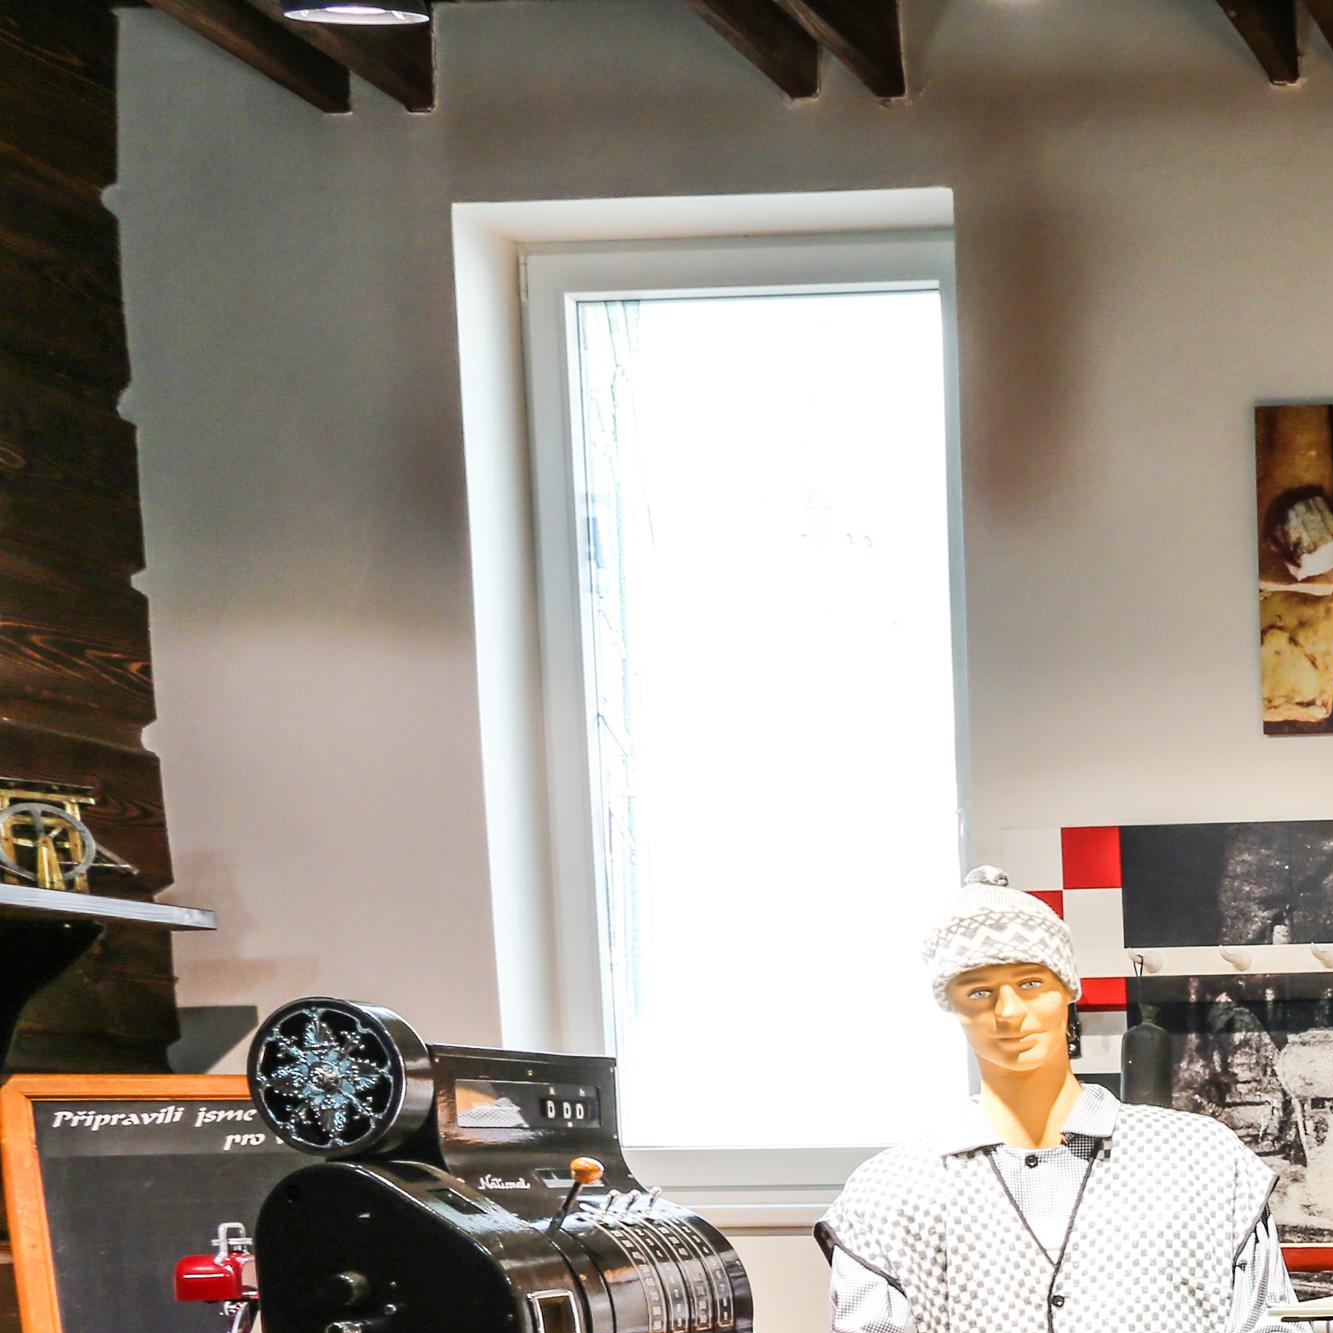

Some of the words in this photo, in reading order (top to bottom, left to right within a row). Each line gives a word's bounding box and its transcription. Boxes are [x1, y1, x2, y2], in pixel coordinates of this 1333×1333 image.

[52, 1105, 185, 1132] Připravili
[194, 1108, 257, 1128] jsme
[224, 1132, 266, 1151] pro
[478, 1174, 530, 1190] National
